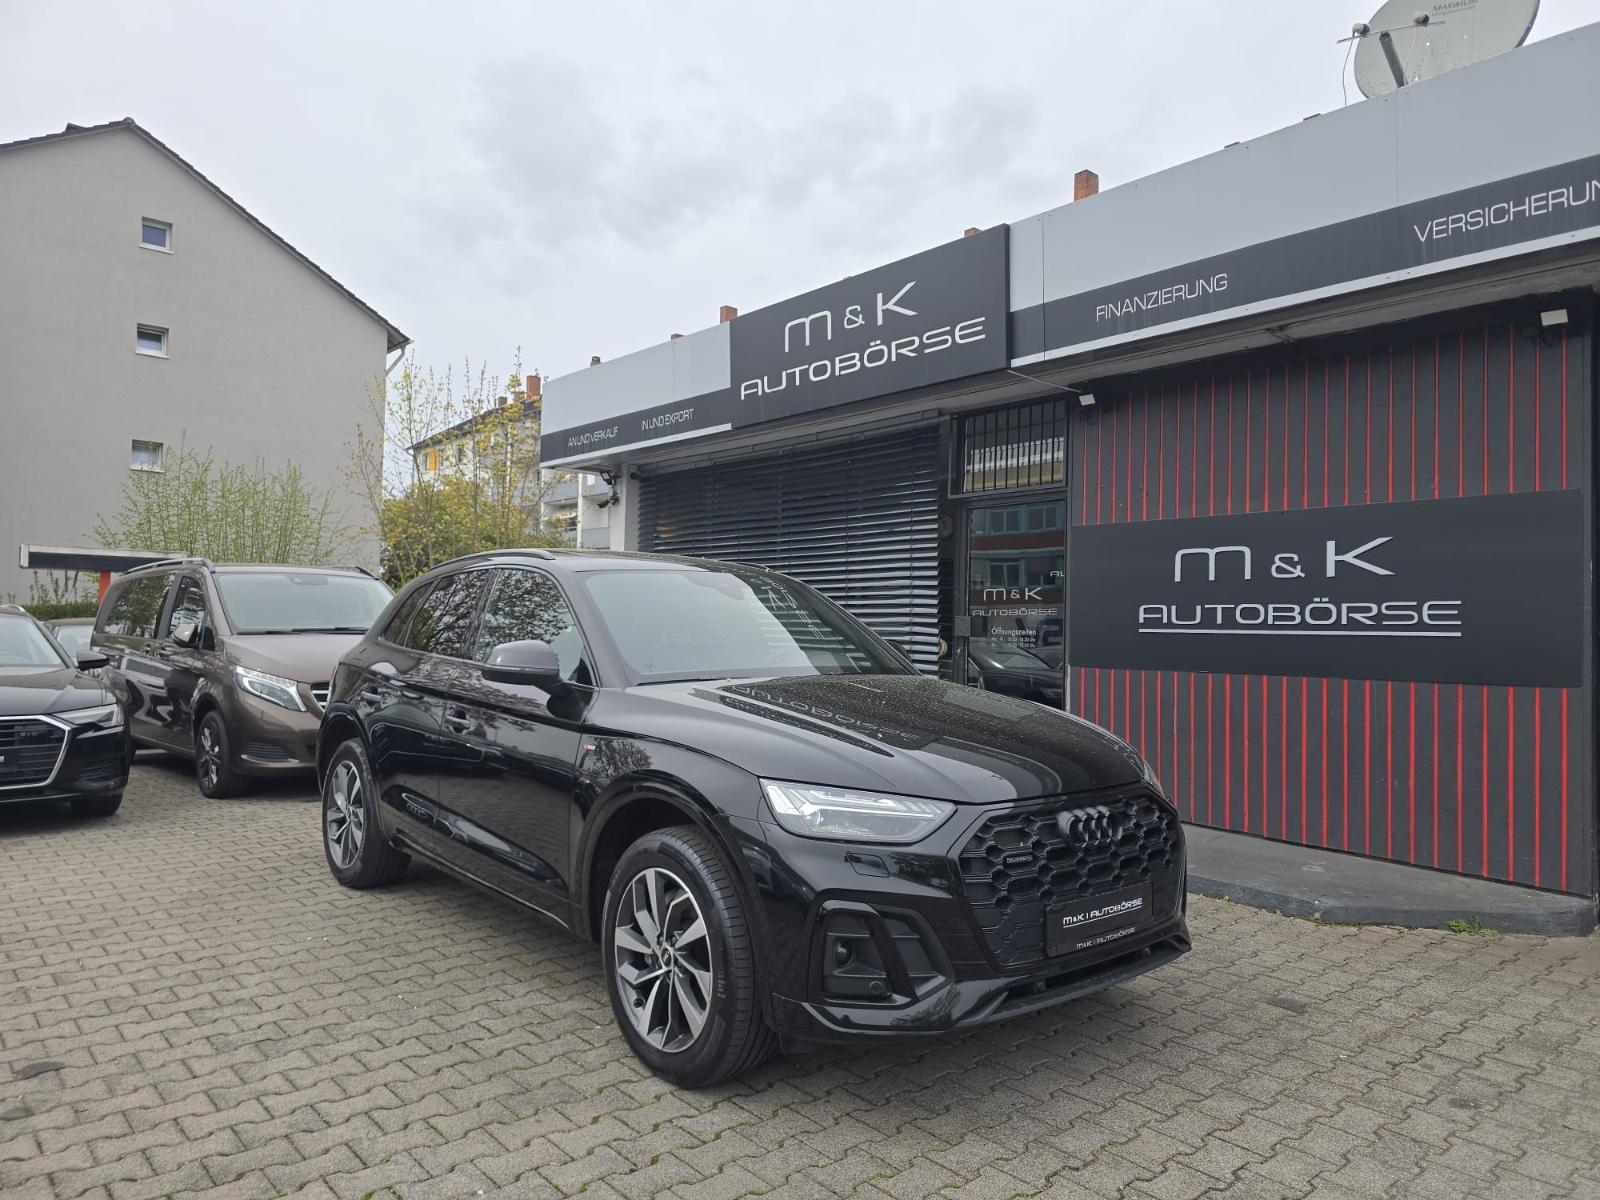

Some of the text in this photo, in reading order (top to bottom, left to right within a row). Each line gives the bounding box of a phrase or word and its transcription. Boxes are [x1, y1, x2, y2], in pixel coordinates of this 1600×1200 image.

[1096, 273, 1228, 322] FINANZIERUNG
[784, 281, 919, 352] M & K
[740, 316, 986, 400] AUTOBÖRSE
[1174, 537, 1395, 582] M & K
[972, 607, 1059, 617] AUTOBÖRSE
[983, 587, 1043, 602] M & K
[1139, 597, 1462, 625] AUTOBÖRSE
[1090, 897, 1143, 918] AUTOBÖRSE
